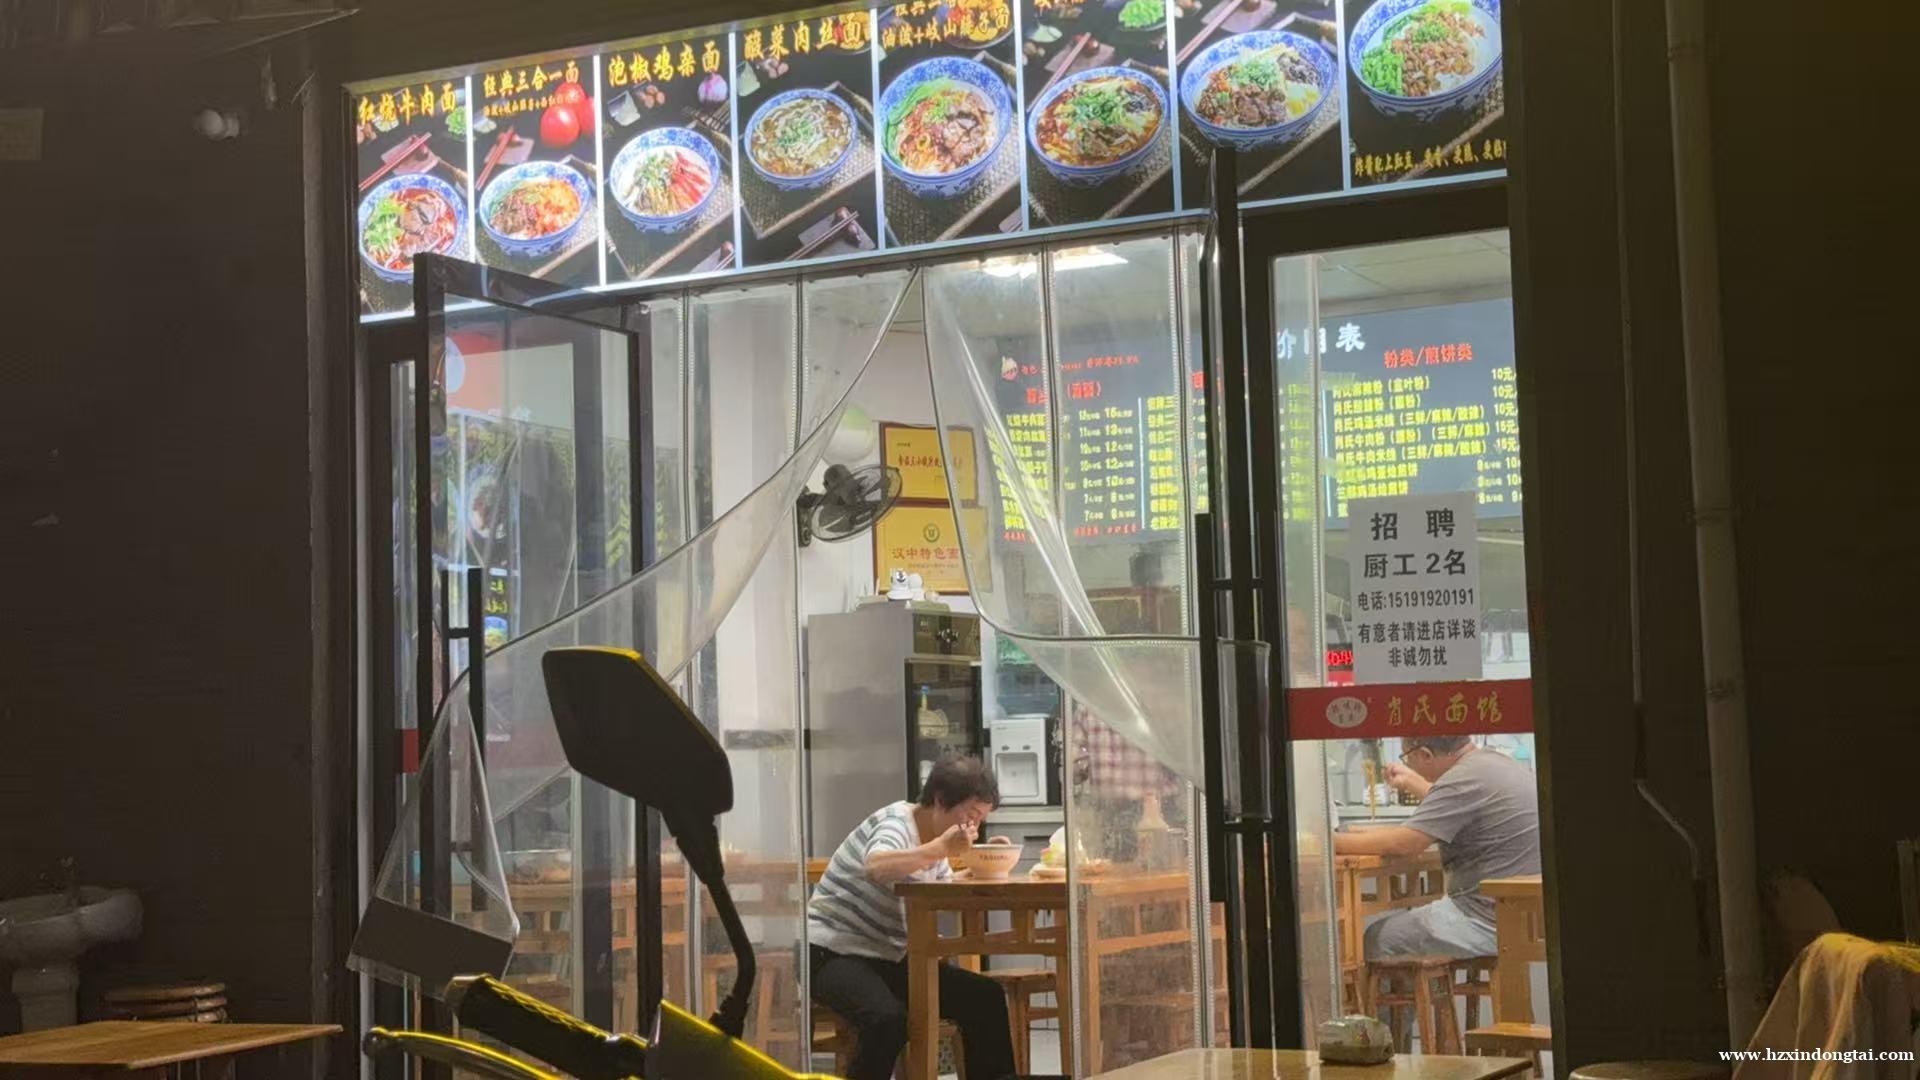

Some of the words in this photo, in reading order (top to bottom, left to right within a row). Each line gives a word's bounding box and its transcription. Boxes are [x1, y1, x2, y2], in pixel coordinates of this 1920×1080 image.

[744, 13, 861, 60] 酸菜肉丝面
[483, 60, 580, 98] 经典三合一面
[608, 41, 721, 88] 泡椒鸡杂面
[358, 82, 456, 126] 红烧牛肉面
[1371, 507, 1456, 541] 招聘
[1364, 549, 1467, 579] 厨工2名
[1357, 588, 1475, 612] 电话:15191920191
[1358, 618, 1477, 644] 有意者请进店详谈
[1388, 645, 1448, 668] 非诚勿扰
[1387, 691, 1503, 727] 肖氏面馆
